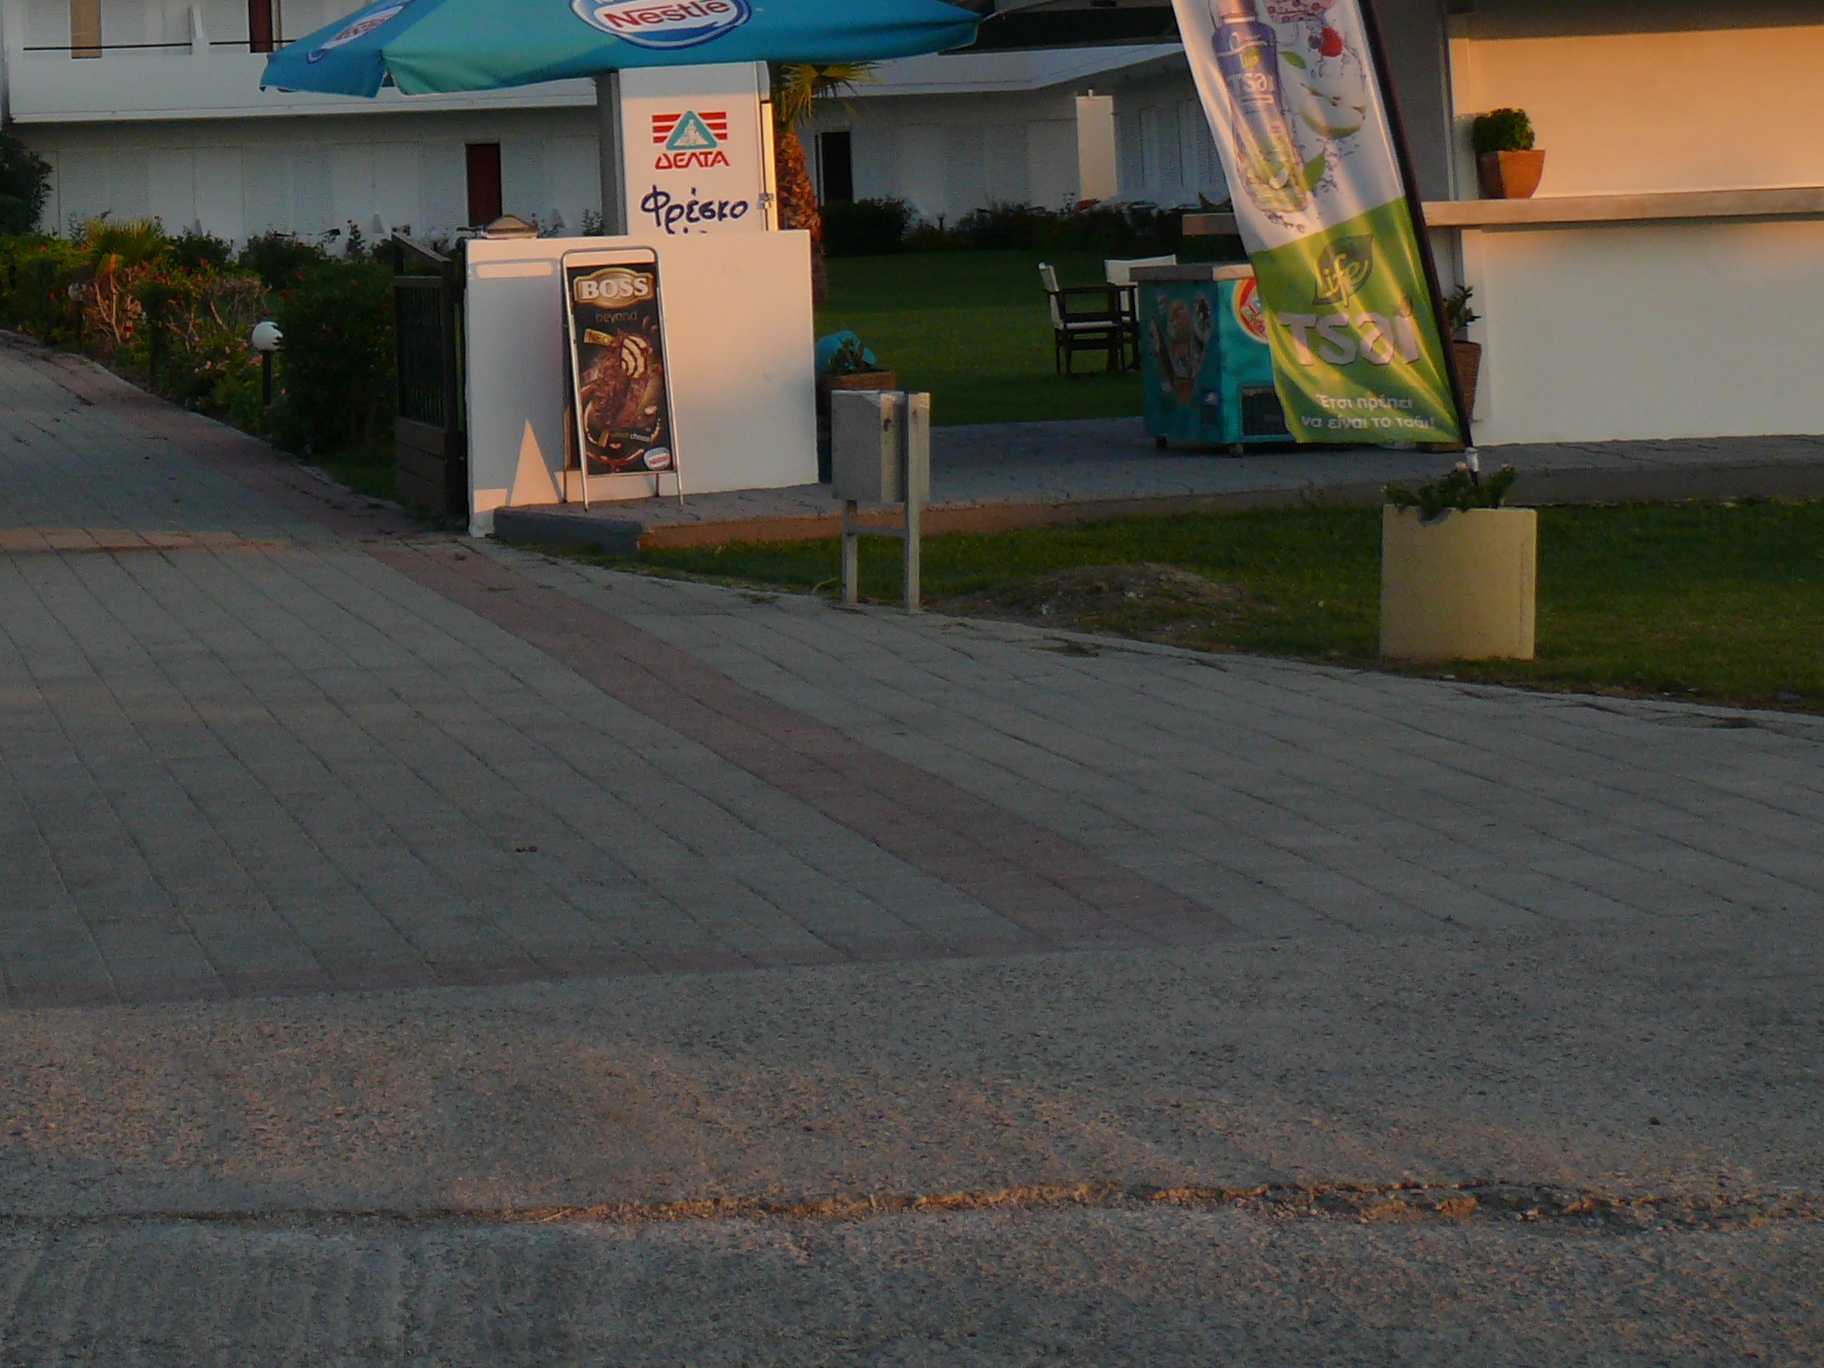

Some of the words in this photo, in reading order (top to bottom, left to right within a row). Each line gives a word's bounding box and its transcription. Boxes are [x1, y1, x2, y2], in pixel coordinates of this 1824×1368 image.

[580, 277, 649, 300] BOSS
[1315, 393, 1353, 409] Έτσι
[1300, 415, 1323, 428] να
[1327, 413, 1368, 429] είναι
[1371, 416, 1392, 429] το
